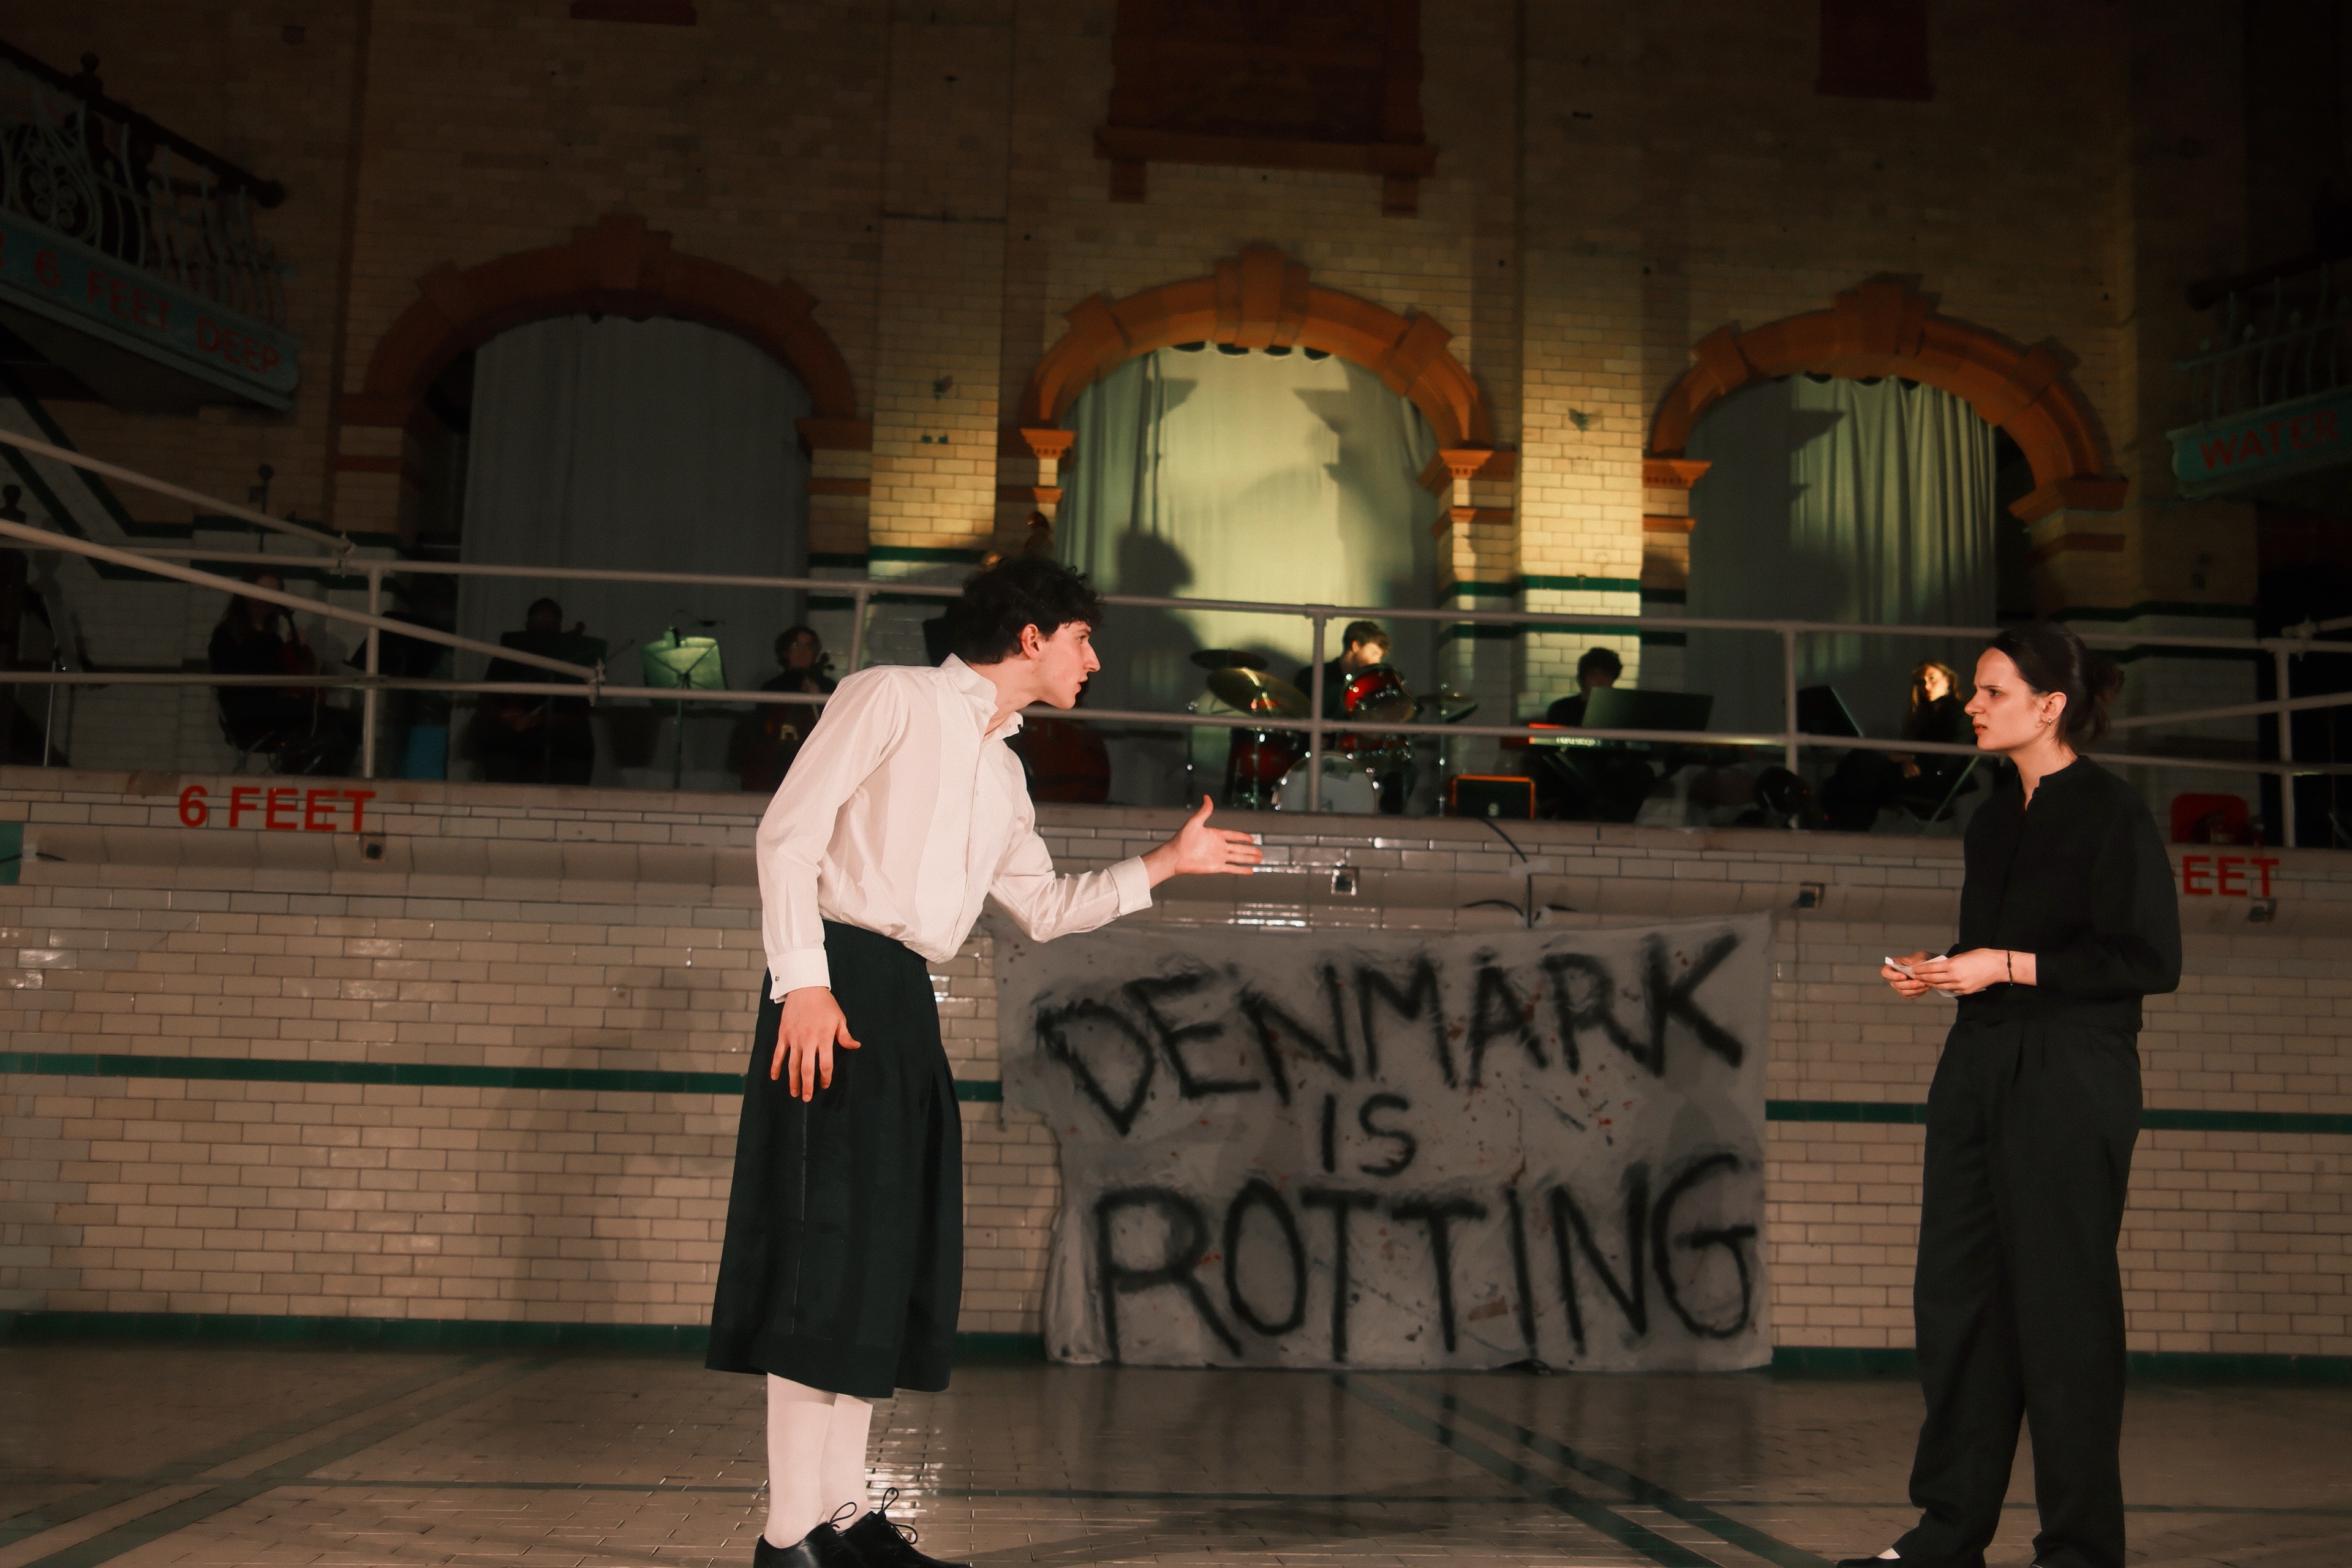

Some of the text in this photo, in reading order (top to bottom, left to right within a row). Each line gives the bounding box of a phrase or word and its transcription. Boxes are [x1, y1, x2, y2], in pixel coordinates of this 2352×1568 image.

[34, 248, 61, 288] 6
[88, 269, 172, 332] FEET
[197, 316, 280, 375] DEEP
[2200, 409, 2341, 470] WATER
[179, 786, 376, 832] 6 FEET
[2172, 856, 2279, 897] EET
[1036, 934, 1744, 1136] DENMARK
[1322, 1094, 1416, 1176] IS
[1095, 1153, 1757, 1362] ROTTING
